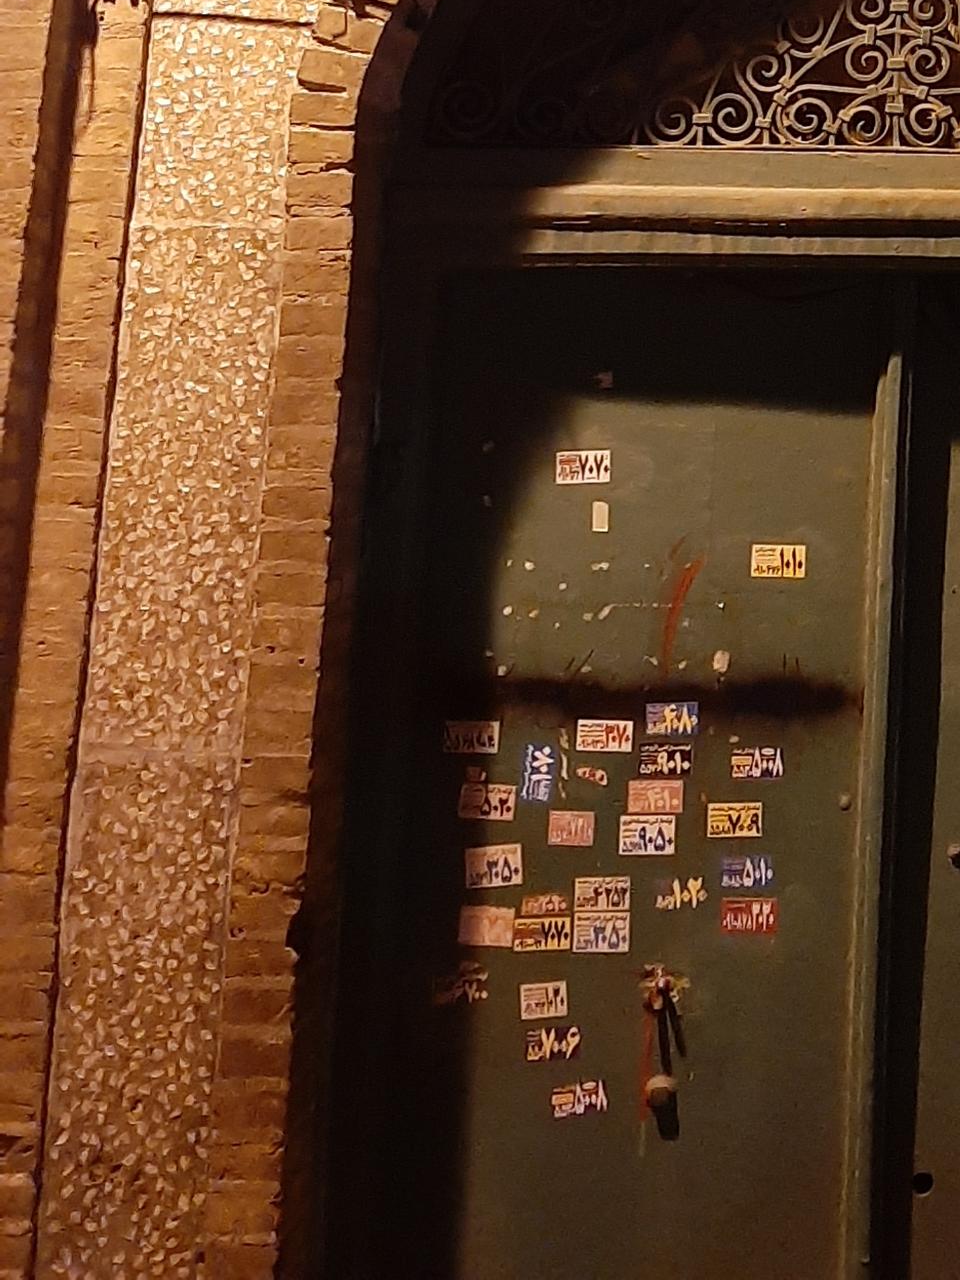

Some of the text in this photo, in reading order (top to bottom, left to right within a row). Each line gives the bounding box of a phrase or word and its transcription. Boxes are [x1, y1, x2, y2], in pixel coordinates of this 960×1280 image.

[579, 453, 610, 481] ۷۰۷۰
[779, 546, 804, 578] ۱۰۱۰
[541, 919, 569, 947] ۷۰۷۰
